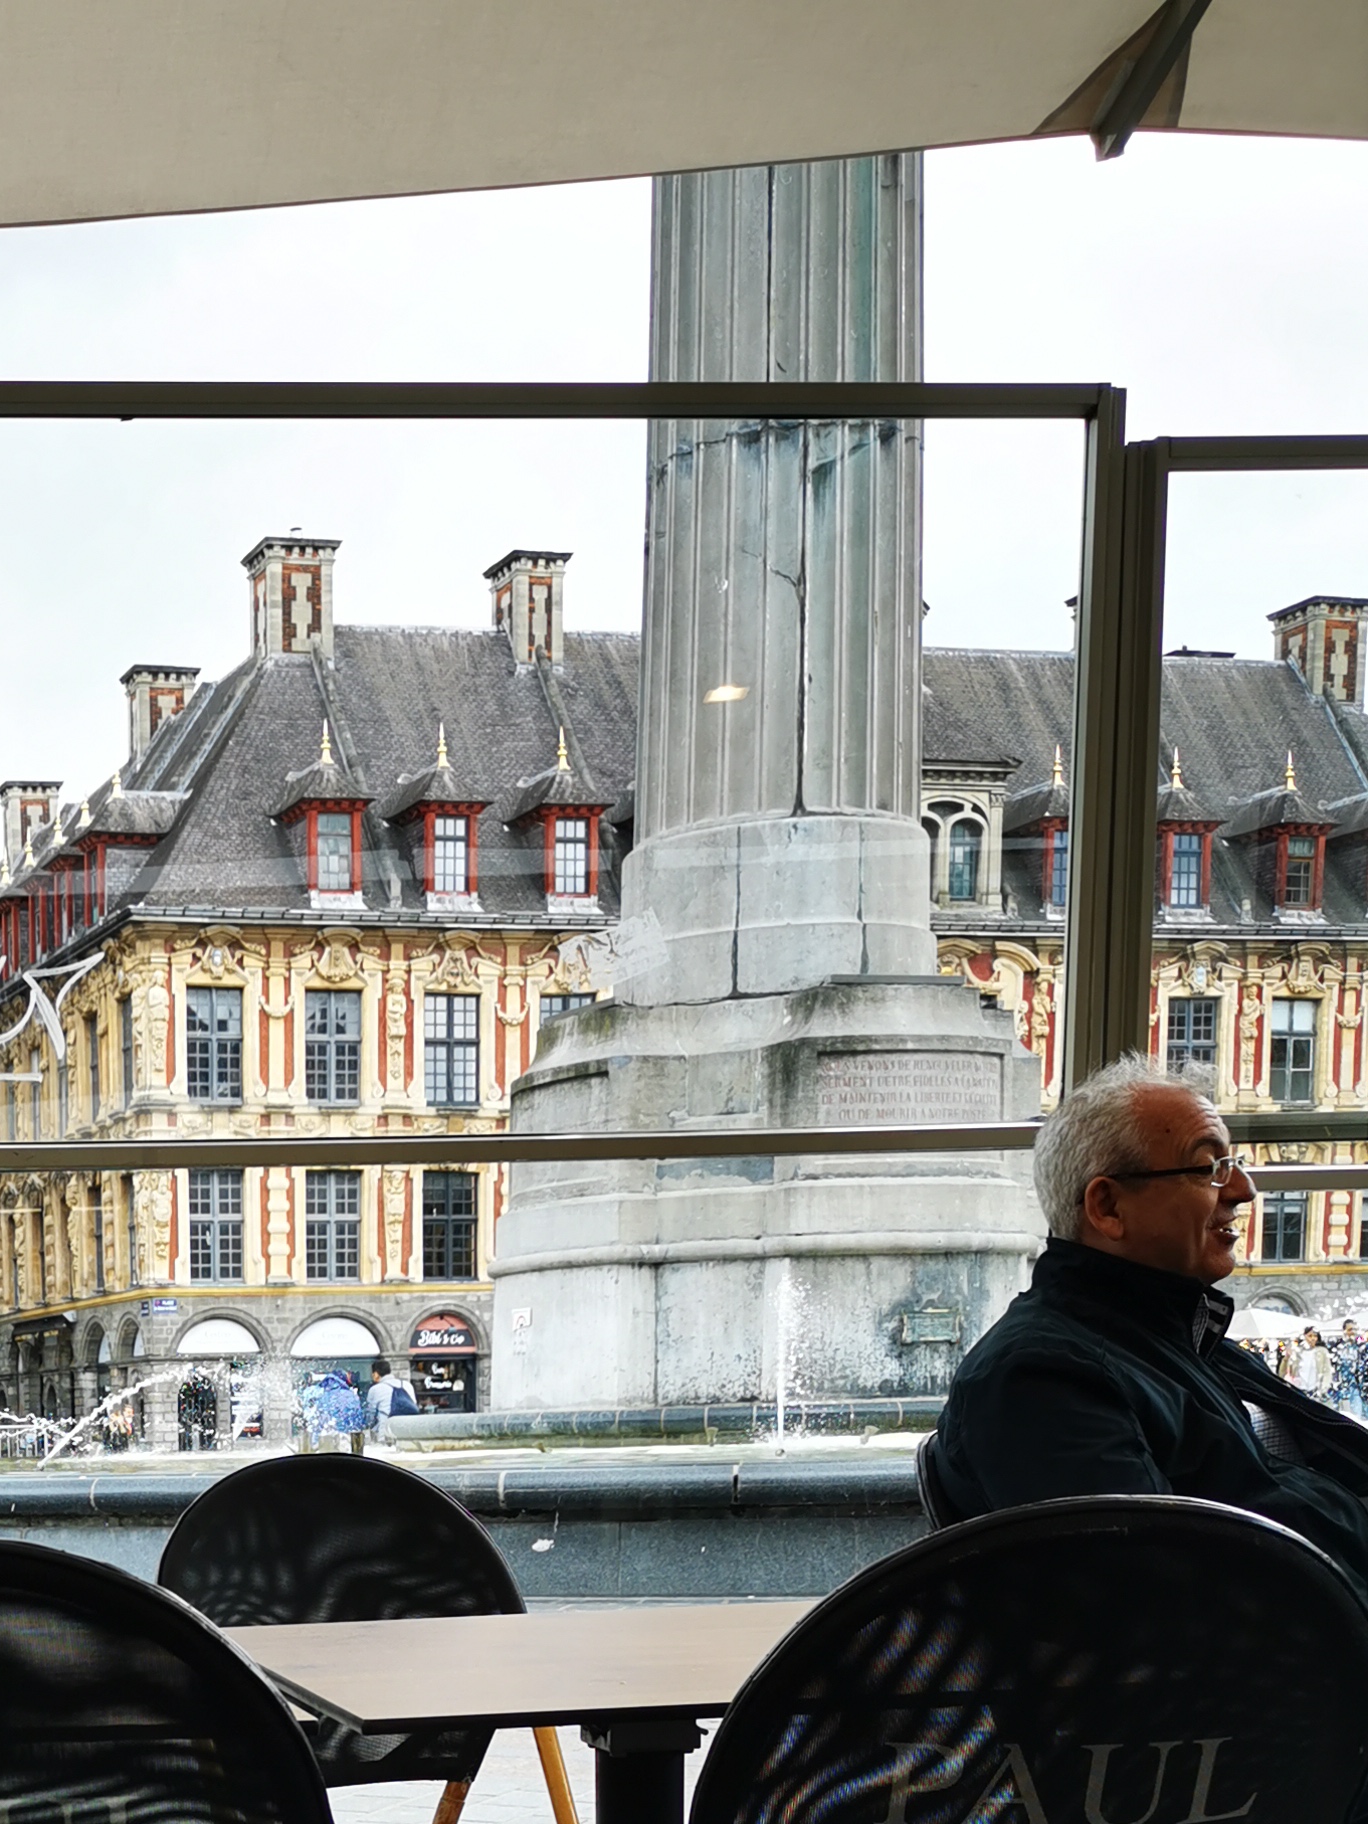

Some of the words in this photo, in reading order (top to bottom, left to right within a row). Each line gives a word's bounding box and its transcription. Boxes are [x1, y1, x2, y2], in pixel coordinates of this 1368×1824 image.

[821, 1094, 834, 1105] DE
[899, 1092, 912, 1104] LA
[858, 1109, 871, 1120] DE
